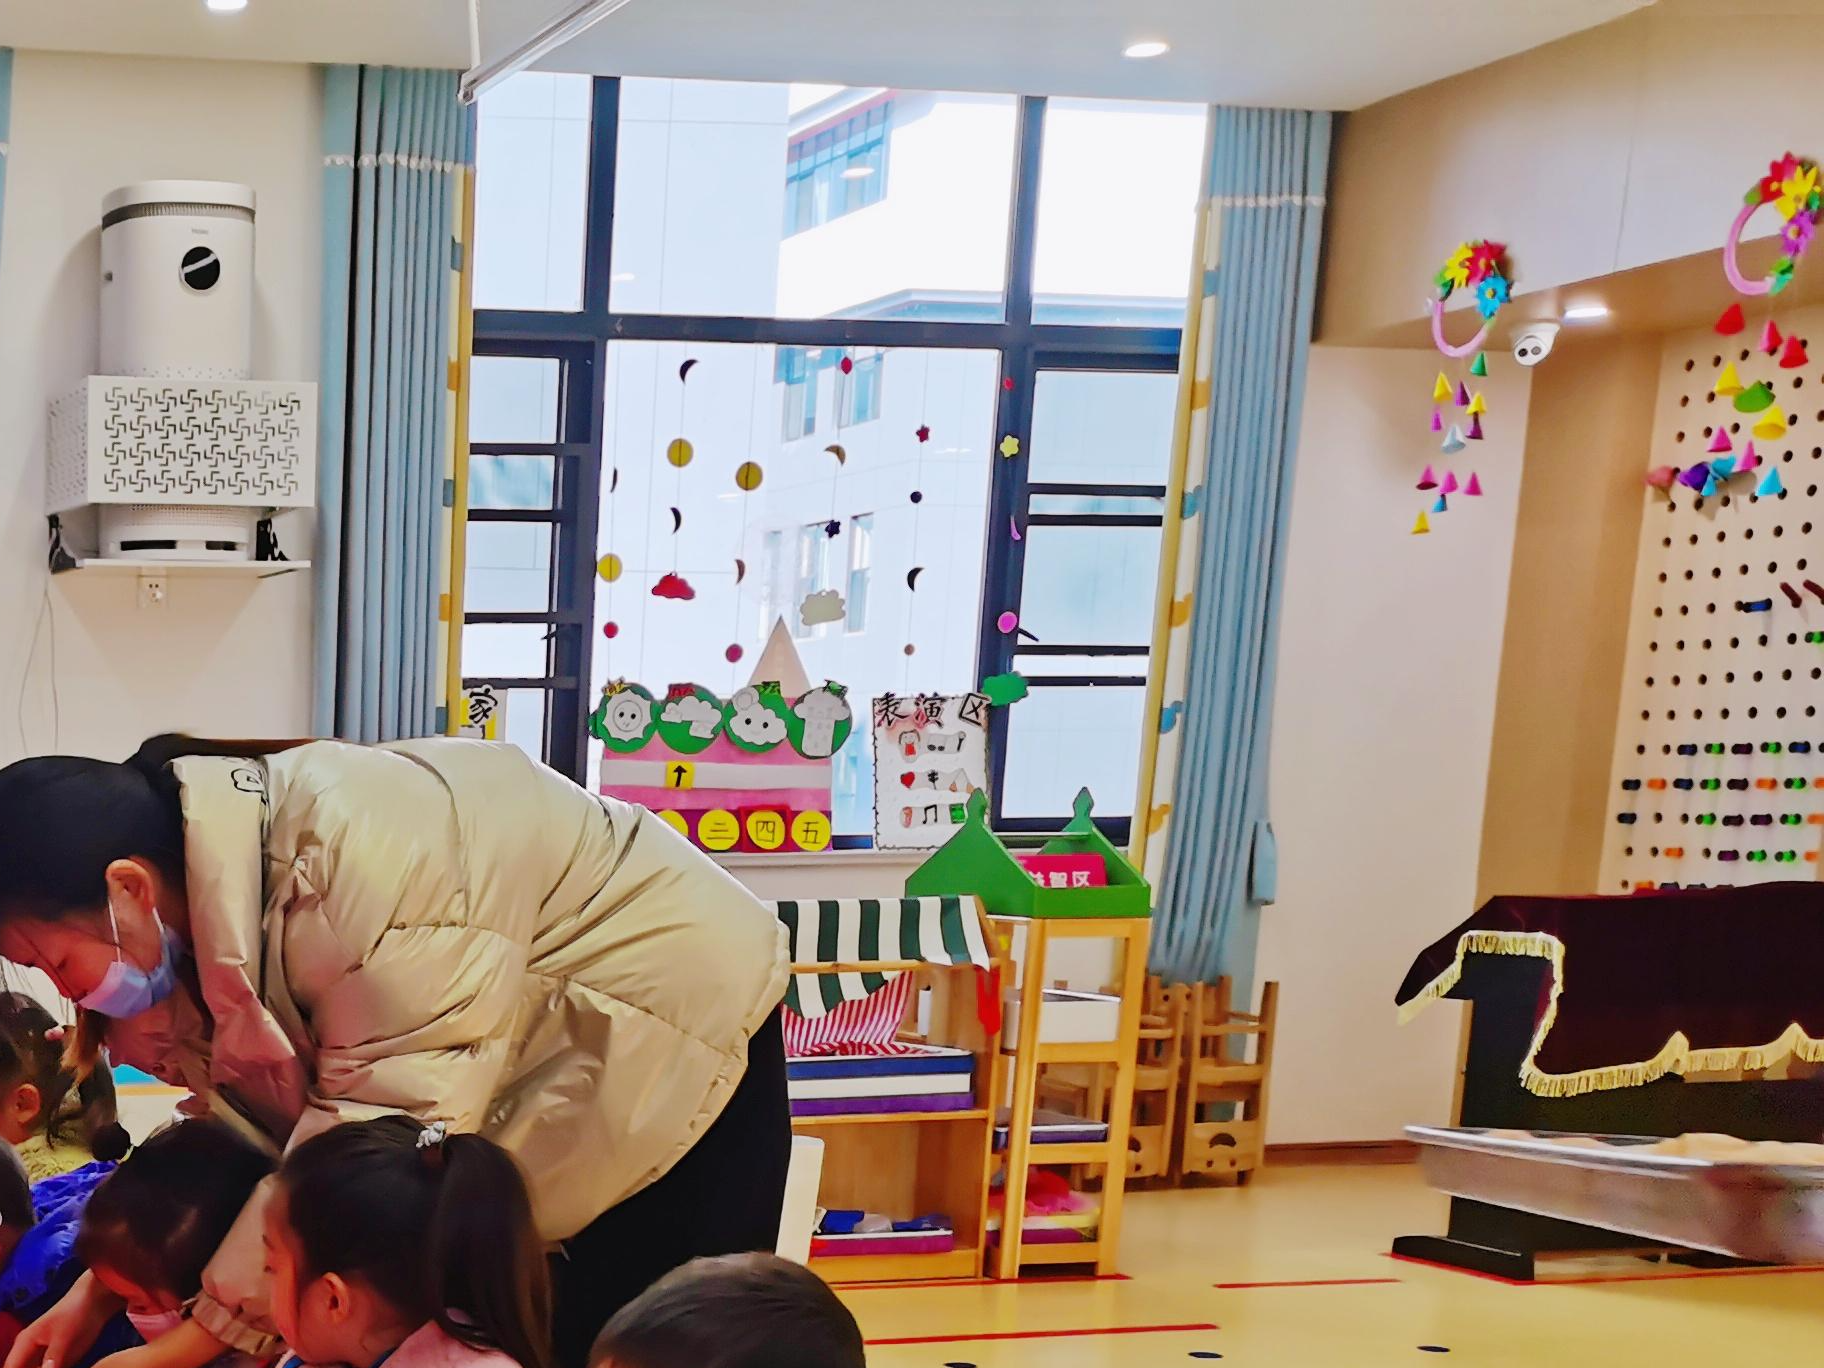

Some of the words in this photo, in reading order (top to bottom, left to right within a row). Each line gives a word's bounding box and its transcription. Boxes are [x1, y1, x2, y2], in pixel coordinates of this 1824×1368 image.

[469, 687, 498, 724] 家
[876, 692, 990, 728] 表演区
[756, 821, 775, 842] 四
[802, 821, 822, 844] 五
